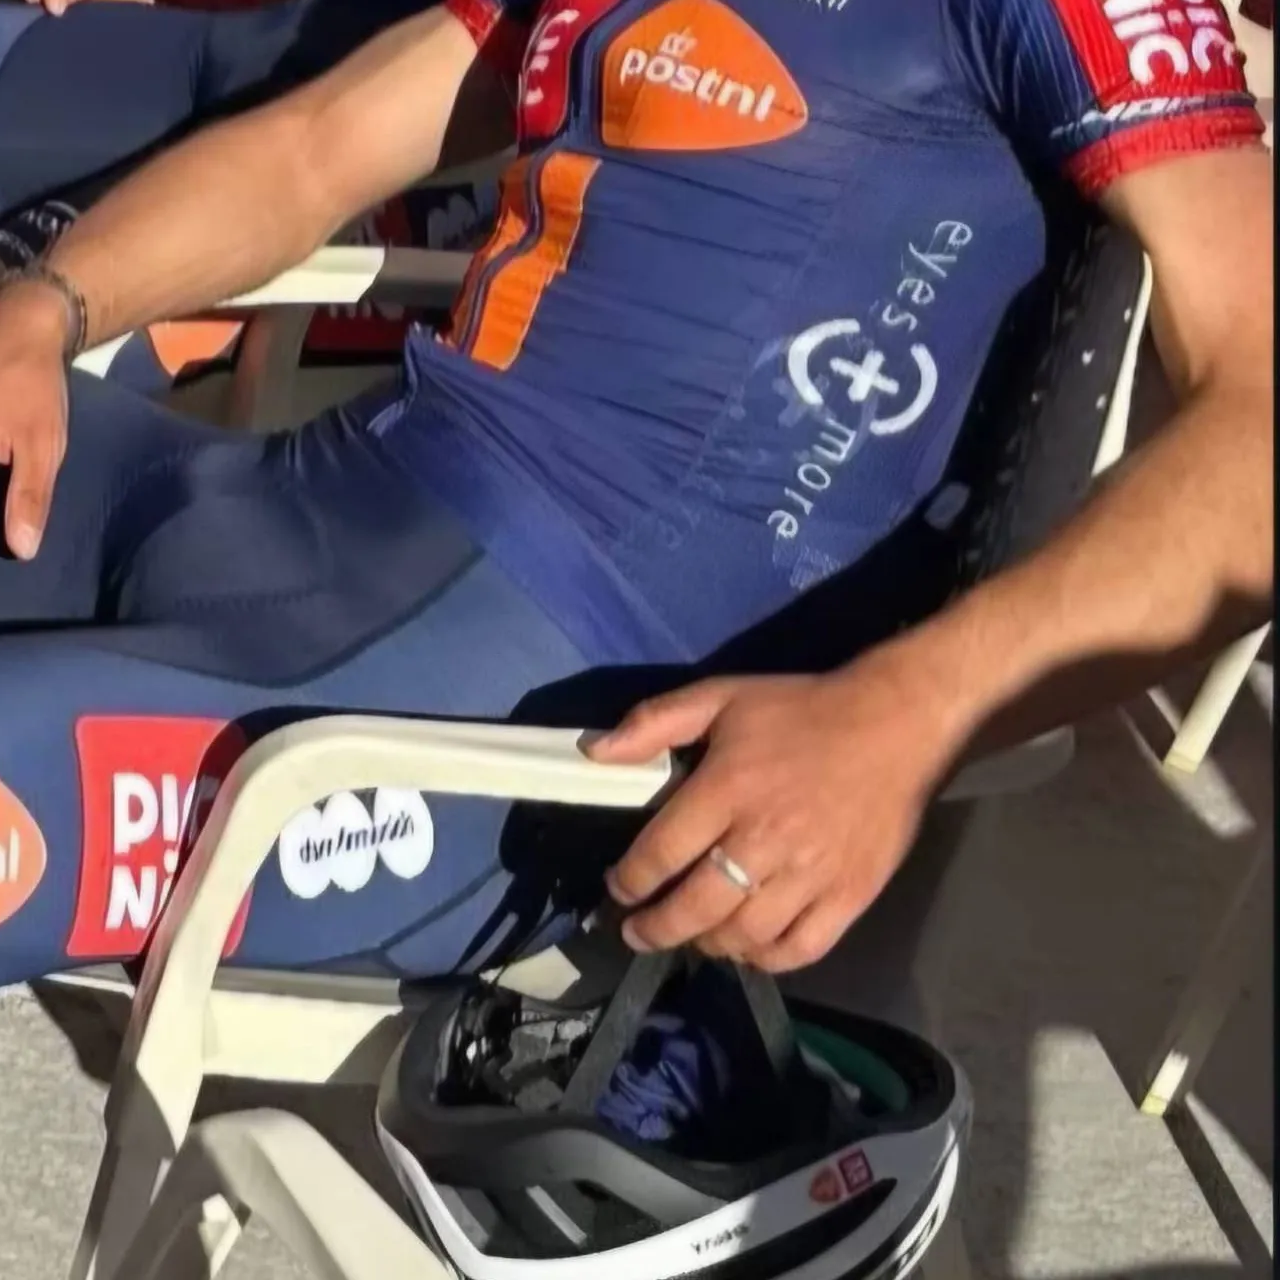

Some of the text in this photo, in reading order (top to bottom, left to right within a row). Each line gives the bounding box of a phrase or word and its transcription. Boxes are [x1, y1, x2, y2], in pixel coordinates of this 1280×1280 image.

[619, 46, 778, 123] postnl
[882, 219, 973, 332] eyes
[766, 414, 857, 540] more
[112, 771, 196, 854] PI
